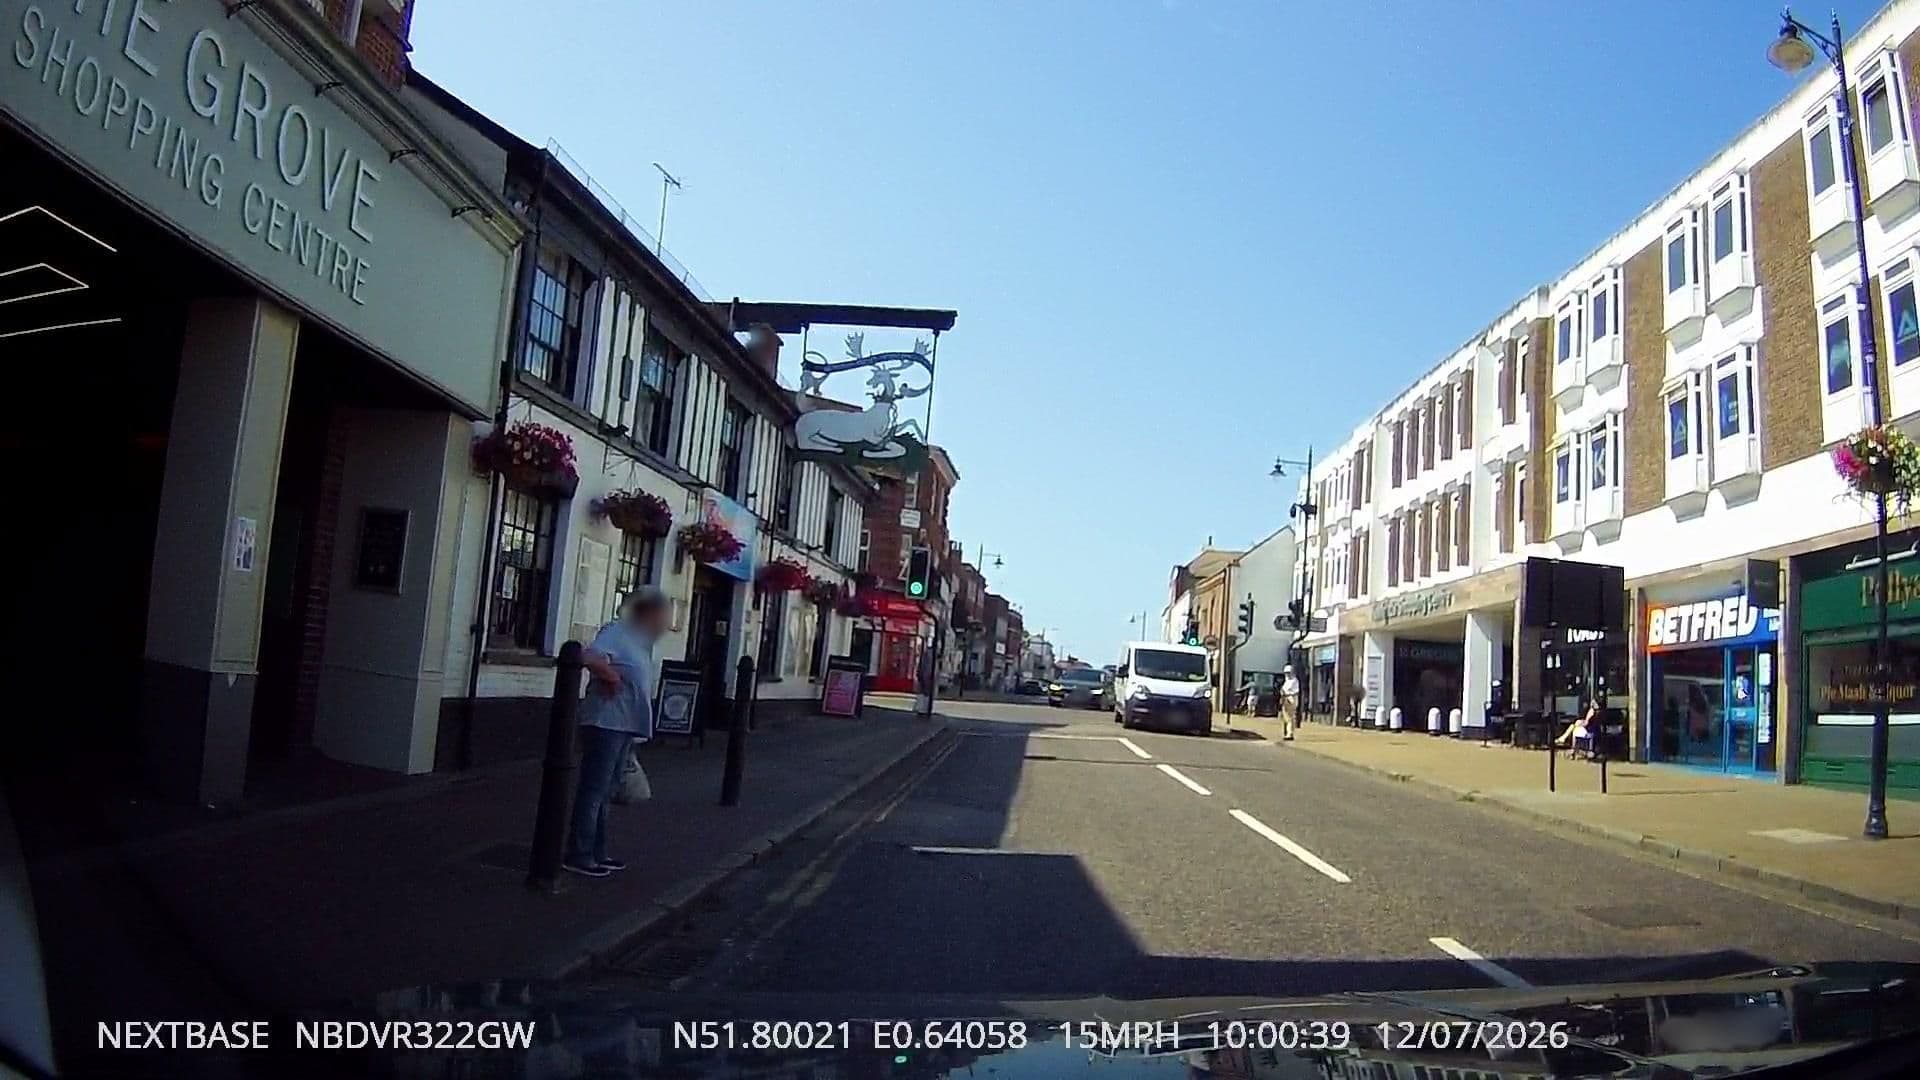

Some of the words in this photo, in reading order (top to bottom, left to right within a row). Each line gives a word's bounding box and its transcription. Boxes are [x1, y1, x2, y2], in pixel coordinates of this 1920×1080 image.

[15, 6, 224, 208] SHOPPING
[244, 182, 371, 305] CENTRE
[186, 29, 381, 243] GROVE
[1648, 595, 1758, 646] BETFRED
